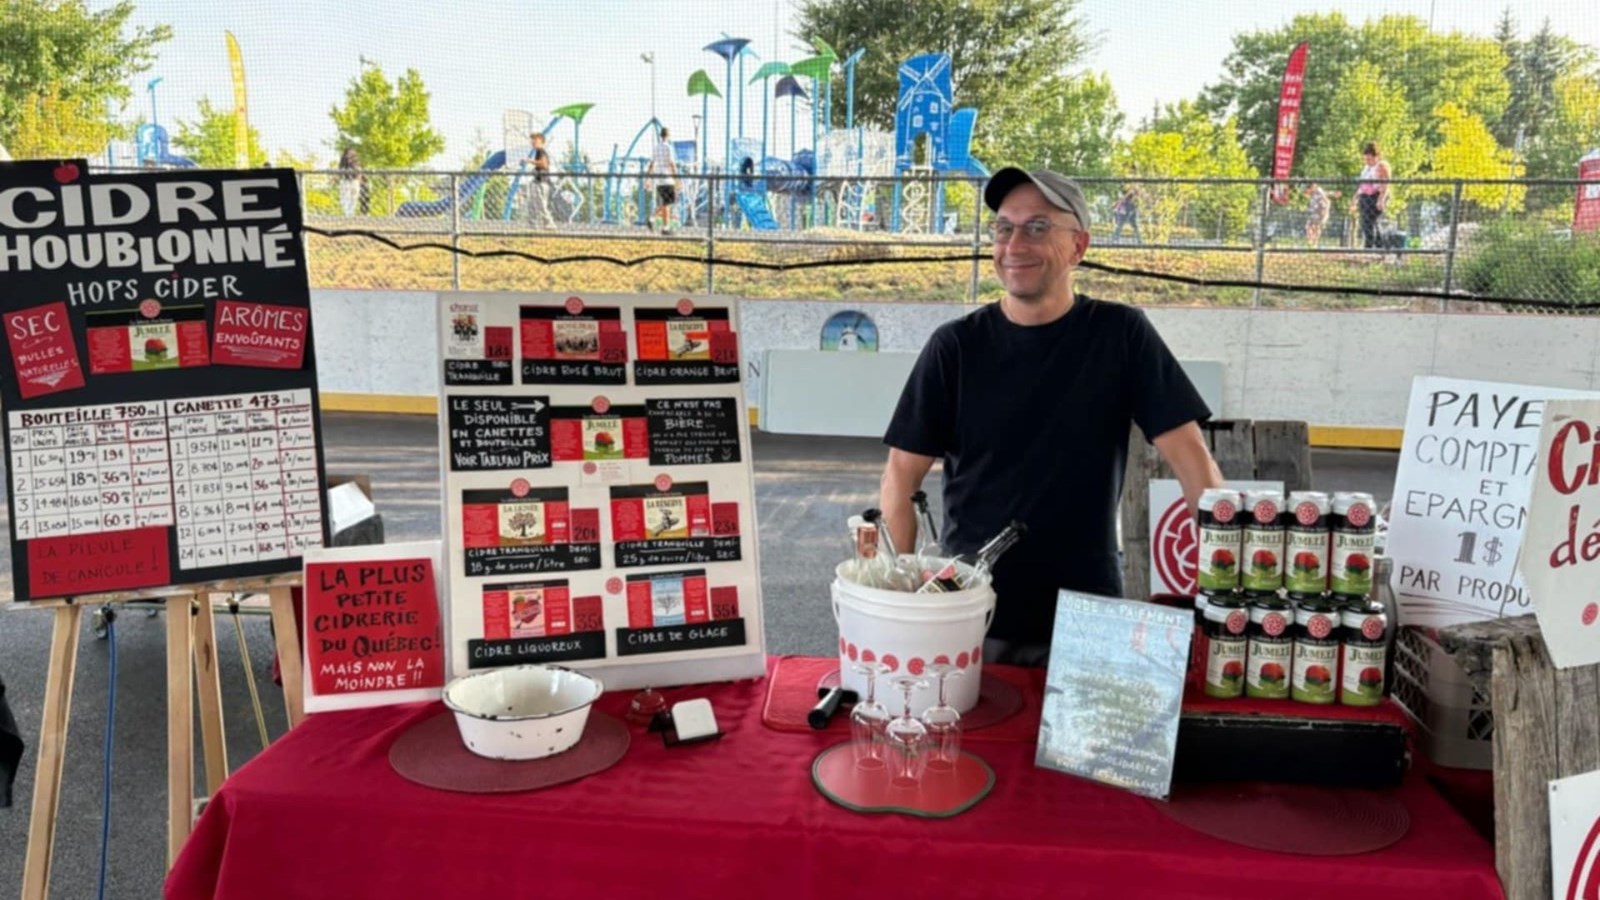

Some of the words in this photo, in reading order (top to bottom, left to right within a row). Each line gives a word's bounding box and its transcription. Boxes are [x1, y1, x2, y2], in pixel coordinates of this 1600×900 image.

[0, 178, 283, 229] CIDRE
[0, 223, 296, 273] HOUBLONNÉ
[67, 278, 140, 306] HOPS
[154, 274, 243, 299] CIDER
[11, 311, 60, 340] SEC
[219, 305, 303, 332] ARÔMES
[215, 331, 300, 349] ENVOÛTANTS
[18, 346, 64, 365] BULLES
[523, 364, 557, 376] CIDRE
[593, 365, 625, 377] BRUT
[636, 366, 667, 377] CIDRE
[669, 366, 710, 376] ORANGE
[713, 365, 739, 376] BRUT
[173, 398, 243, 415] CANETTE
[249, 394, 280, 408] 473
[453, 400, 469, 410] LE
[474, 400, 506, 411] SEUL
[704, 400, 722, 409] PAS
[1427, 389, 1546, 430] PAYE
[20, 408, 112, 428] BOUTEILLE
[115, 405, 146, 418] 750
[464, 412, 537, 425] DISPONIBLE
[664, 417, 704, 430] BIÈRE
[452, 429, 469, 438] EN
[475, 427, 544, 437] CANETTES
[475, 439, 537, 447] BOUTEILLES
[479, 451, 521, 467] TABLEAU
[522, 451, 549, 467] PRIX
[664, 453, 713, 464] POMMES
[176, 463, 185, 477] 2
[1479, 479, 1508, 497] ET
[18, 498, 28, 512] 3
[178, 504, 190, 519] 8
[19, 519, 29, 534] 4
[468, 547, 498, 558] CIDRE
[320, 567, 349, 591] LA
[359, 563, 426, 587] PLUS
[1400, 565, 1441, 592] PAR
[335, 590, 408, 609] PETITE
[314, 611, 419, 634] CIDRERIE
[628, 631, 665, 645] CIDRE
[688, 626, 729, 640] GLACE
[319, 637, 347, 654] DU
[475, 643, 512, 658] CIDRE
[518, 641, 582, 655] LIQUOREUX
[320, 660, 363, 676] MAIS
[367, 659, 398, 672] NON
[406, 657, 425, 670] LA
[334, 673, 407, 691] MOINDRE
